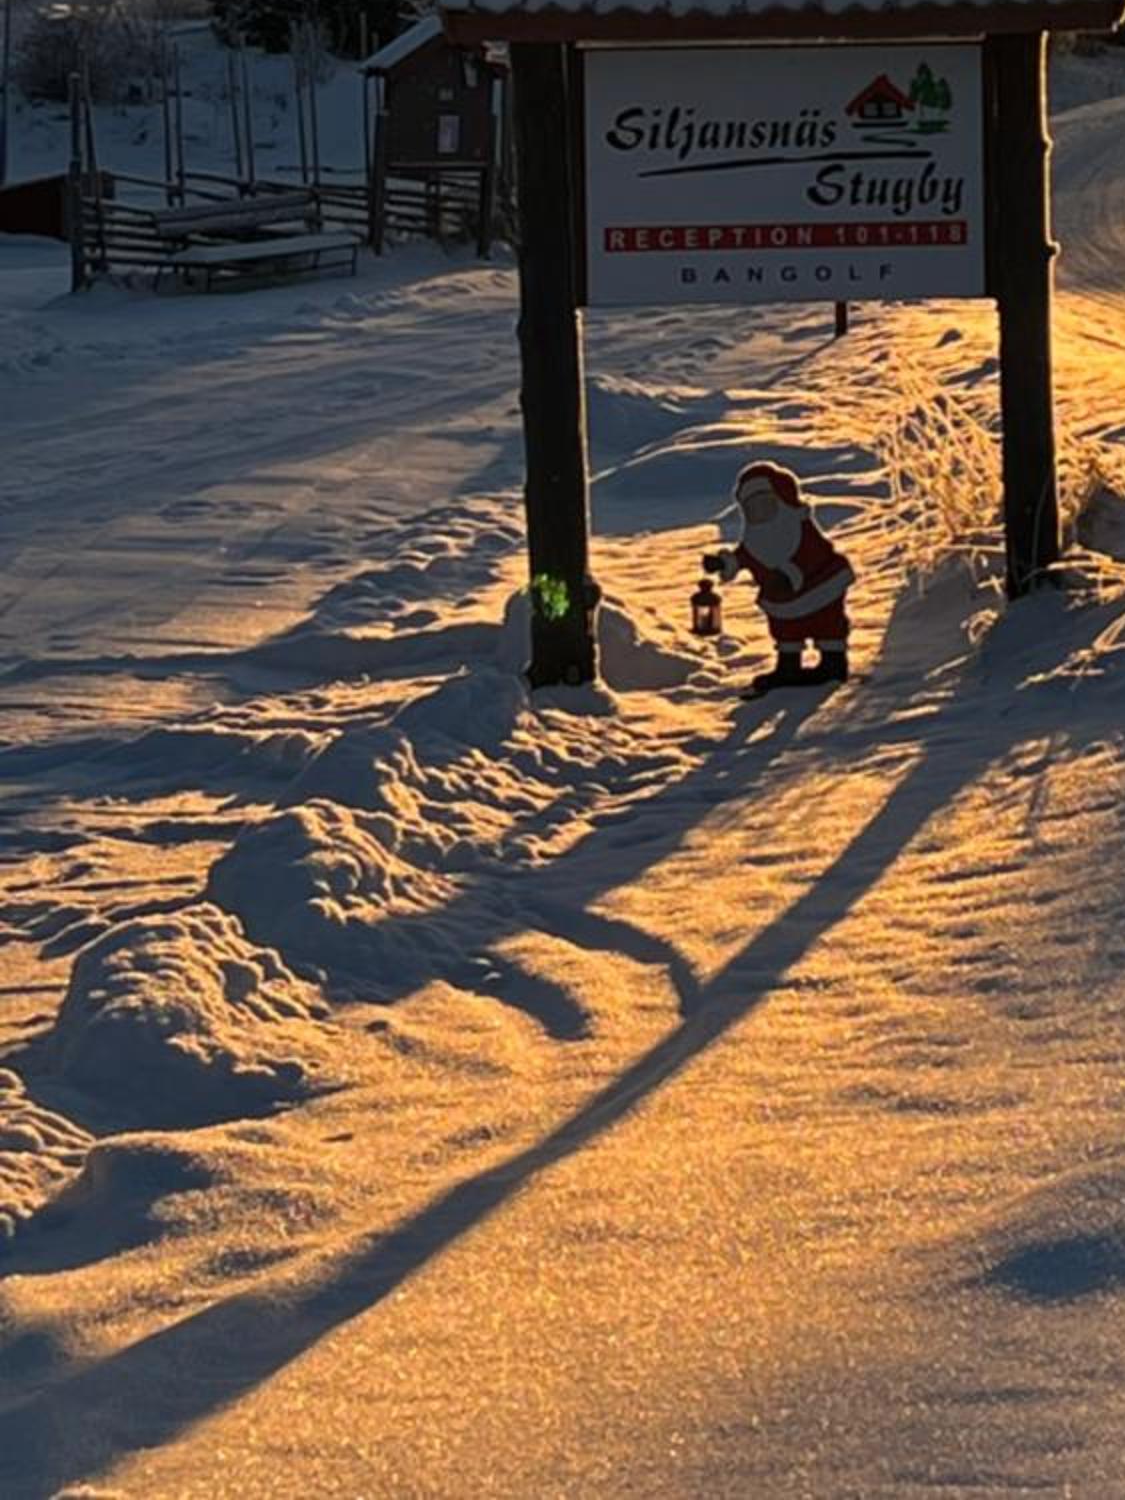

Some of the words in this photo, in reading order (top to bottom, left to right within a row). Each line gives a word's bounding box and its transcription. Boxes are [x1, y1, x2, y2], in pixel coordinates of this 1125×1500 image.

[606, 107, 837, 159] Siljansnäs
[807, 162, 964, 215] Stugby
[610, 226, 815, 249] RECEPTION
[681, 264, 893, 285] BANGOLF
